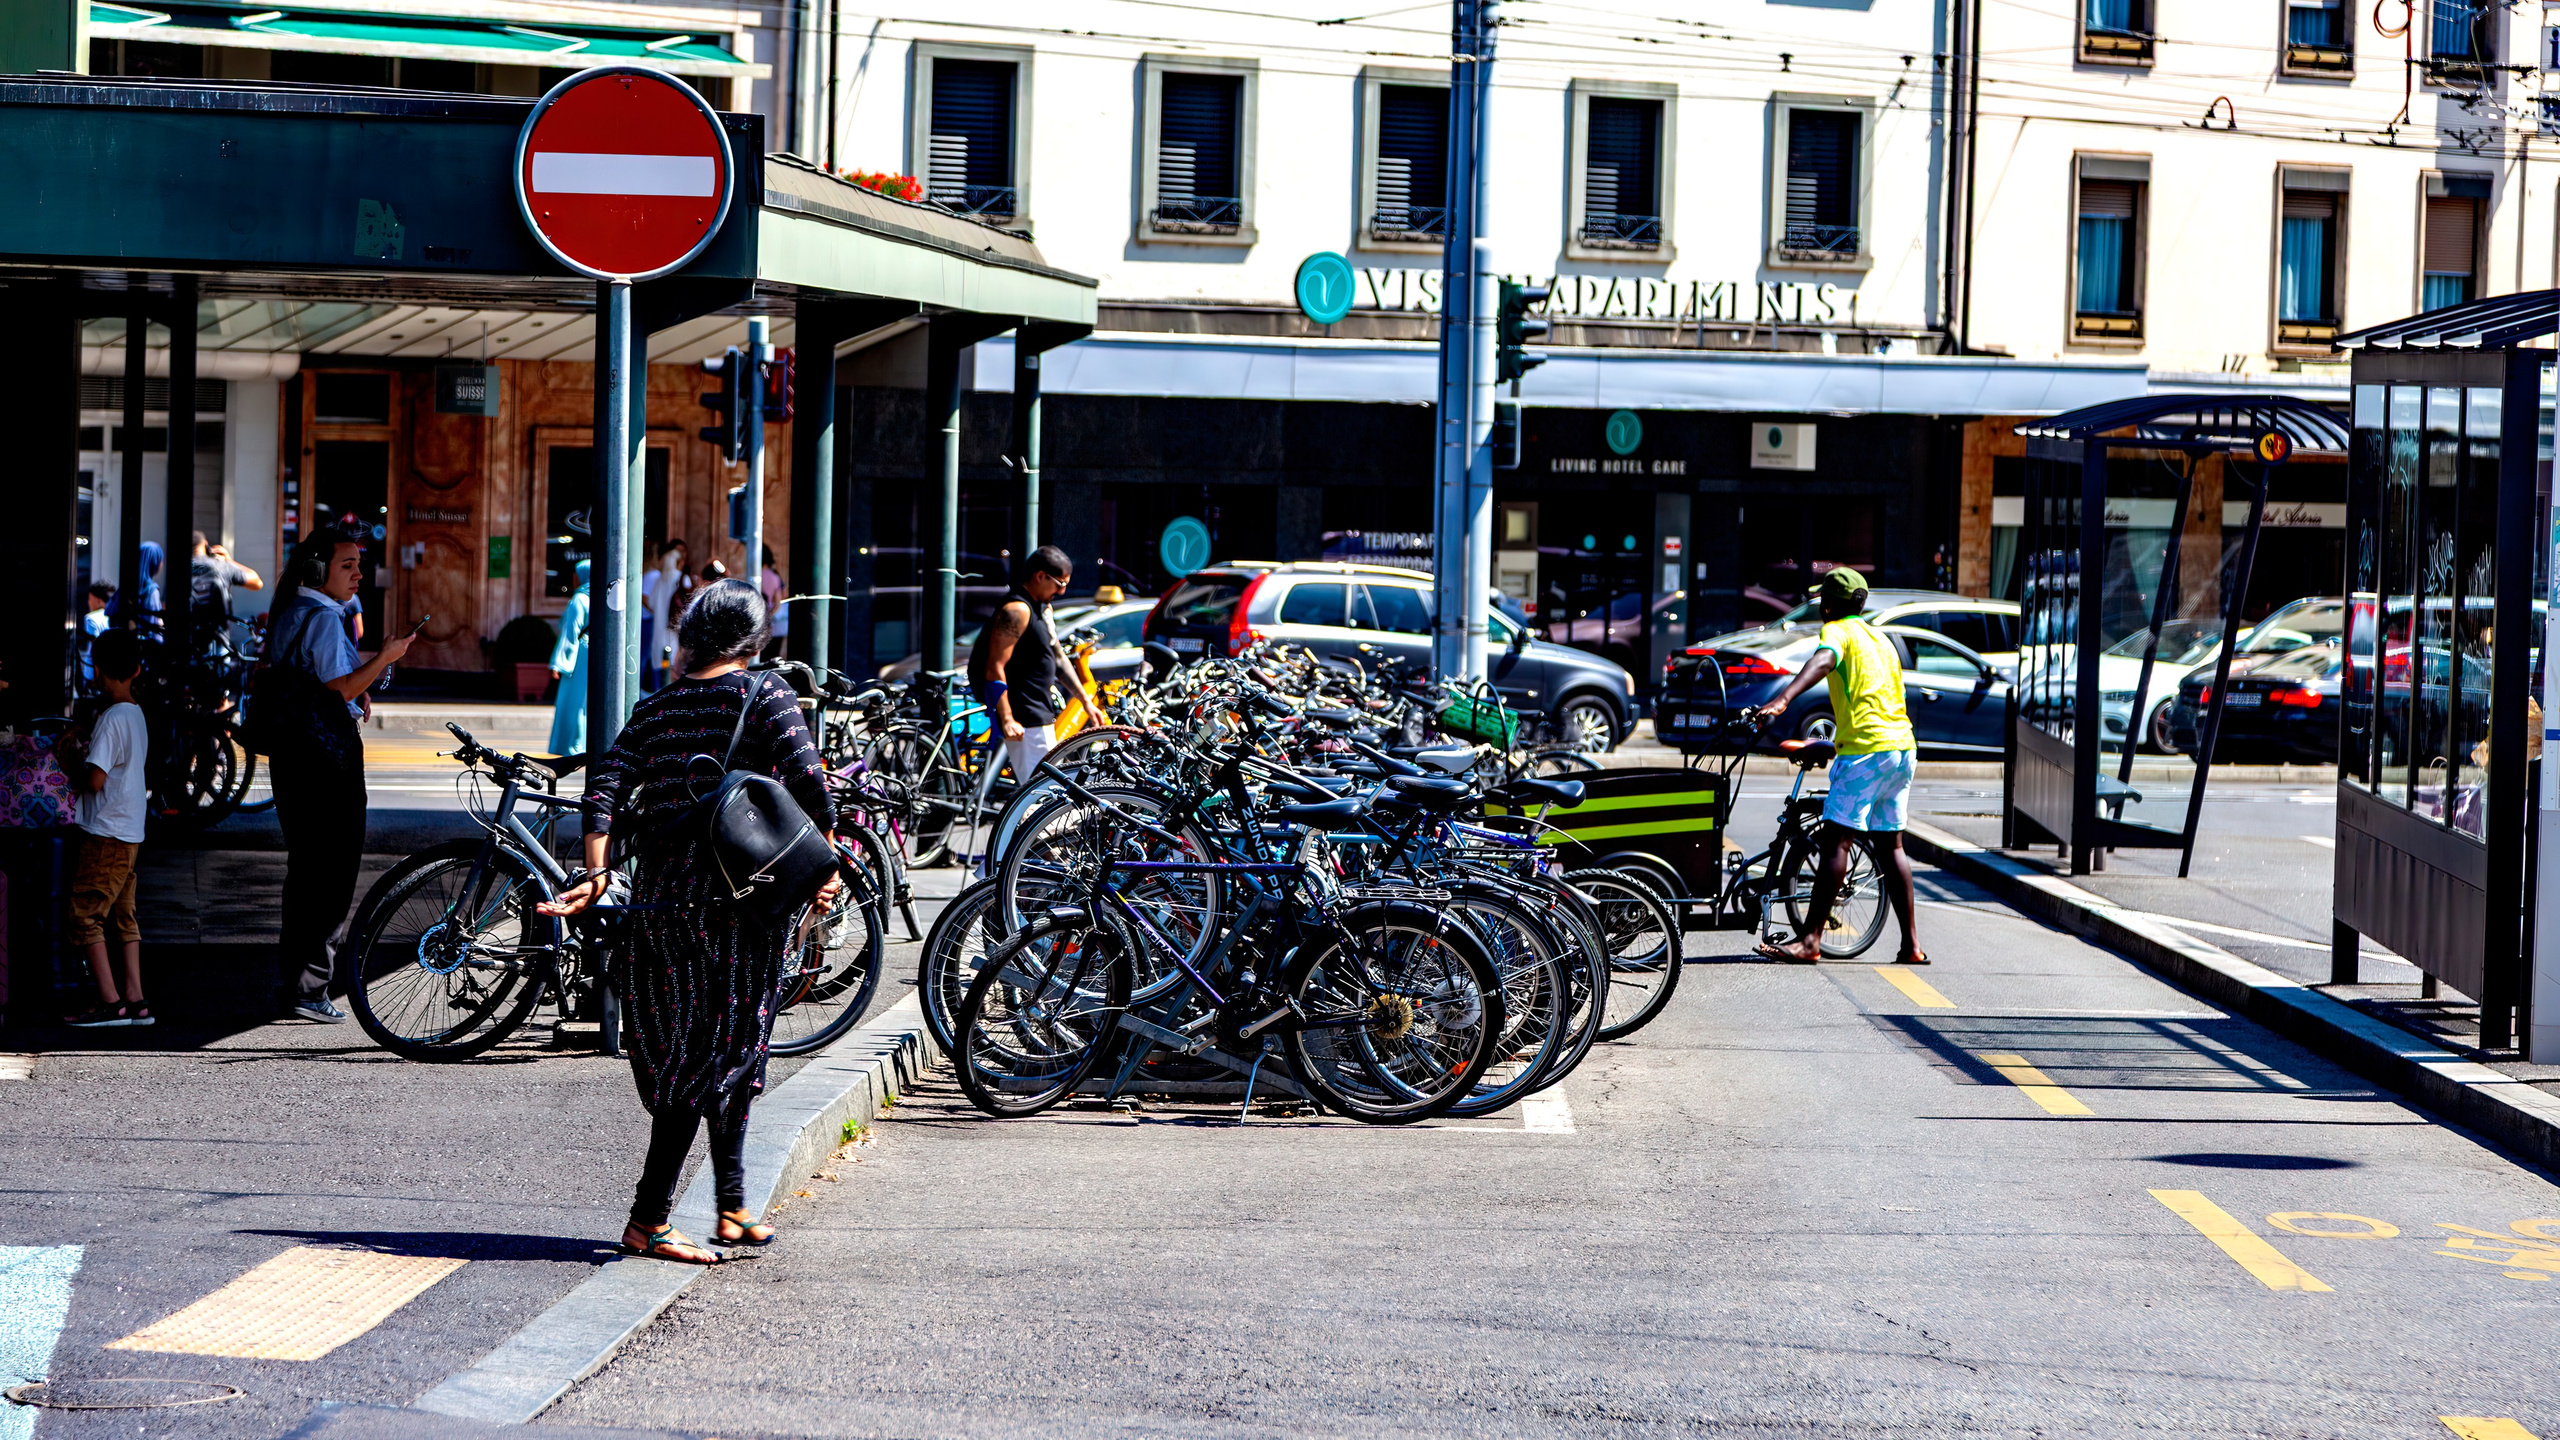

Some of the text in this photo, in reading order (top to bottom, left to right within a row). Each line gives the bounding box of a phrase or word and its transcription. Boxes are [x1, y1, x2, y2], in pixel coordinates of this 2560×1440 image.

[1551, 458, 1687, 475] LIVING HOTEL GARE
[1363, 532, 1434, 550] TEMPORAR
